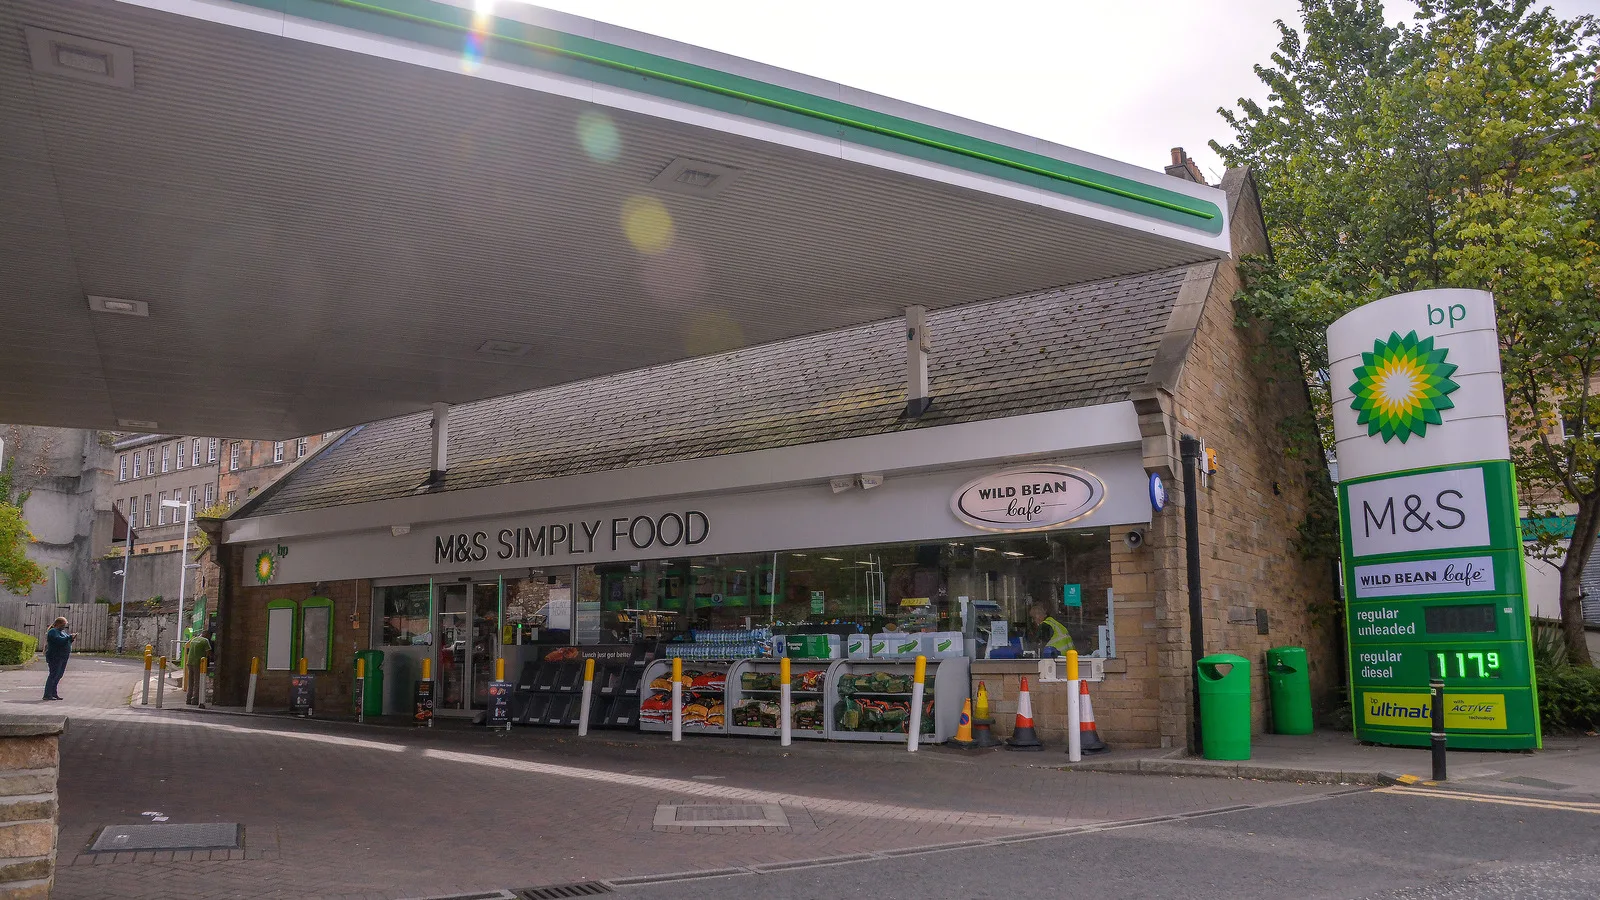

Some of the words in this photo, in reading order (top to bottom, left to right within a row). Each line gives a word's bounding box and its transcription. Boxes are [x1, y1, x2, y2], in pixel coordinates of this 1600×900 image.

[1427, 303, 1467, 329] bp
[978, 486, 1017, 500] WILD
[1021, 481, 1067, 497] BEAN
[1363, 489, 1466, 538] M&S
[434, 530, 489, 564] M&S
[496, 520, 602, 560] SIMPLY
[611, 510, 711, 551] FOOD
[277, 543, 289, 558] bp
[1360, 574, 1392, 586] WILD
[1394, 570, 1437, 584] BEAN
[1357, 607, 1399, 623] regular
[1358, 622, 1416, 636] unleaded
[597, 651, 607, 659] just
[1360, 650, 1402, 665] regular
[1361, 666, 1393, 678] diesel
[1370, 702, 1433, 719] ultimat
[1451, 705, 1494, 713] ACTIVE
